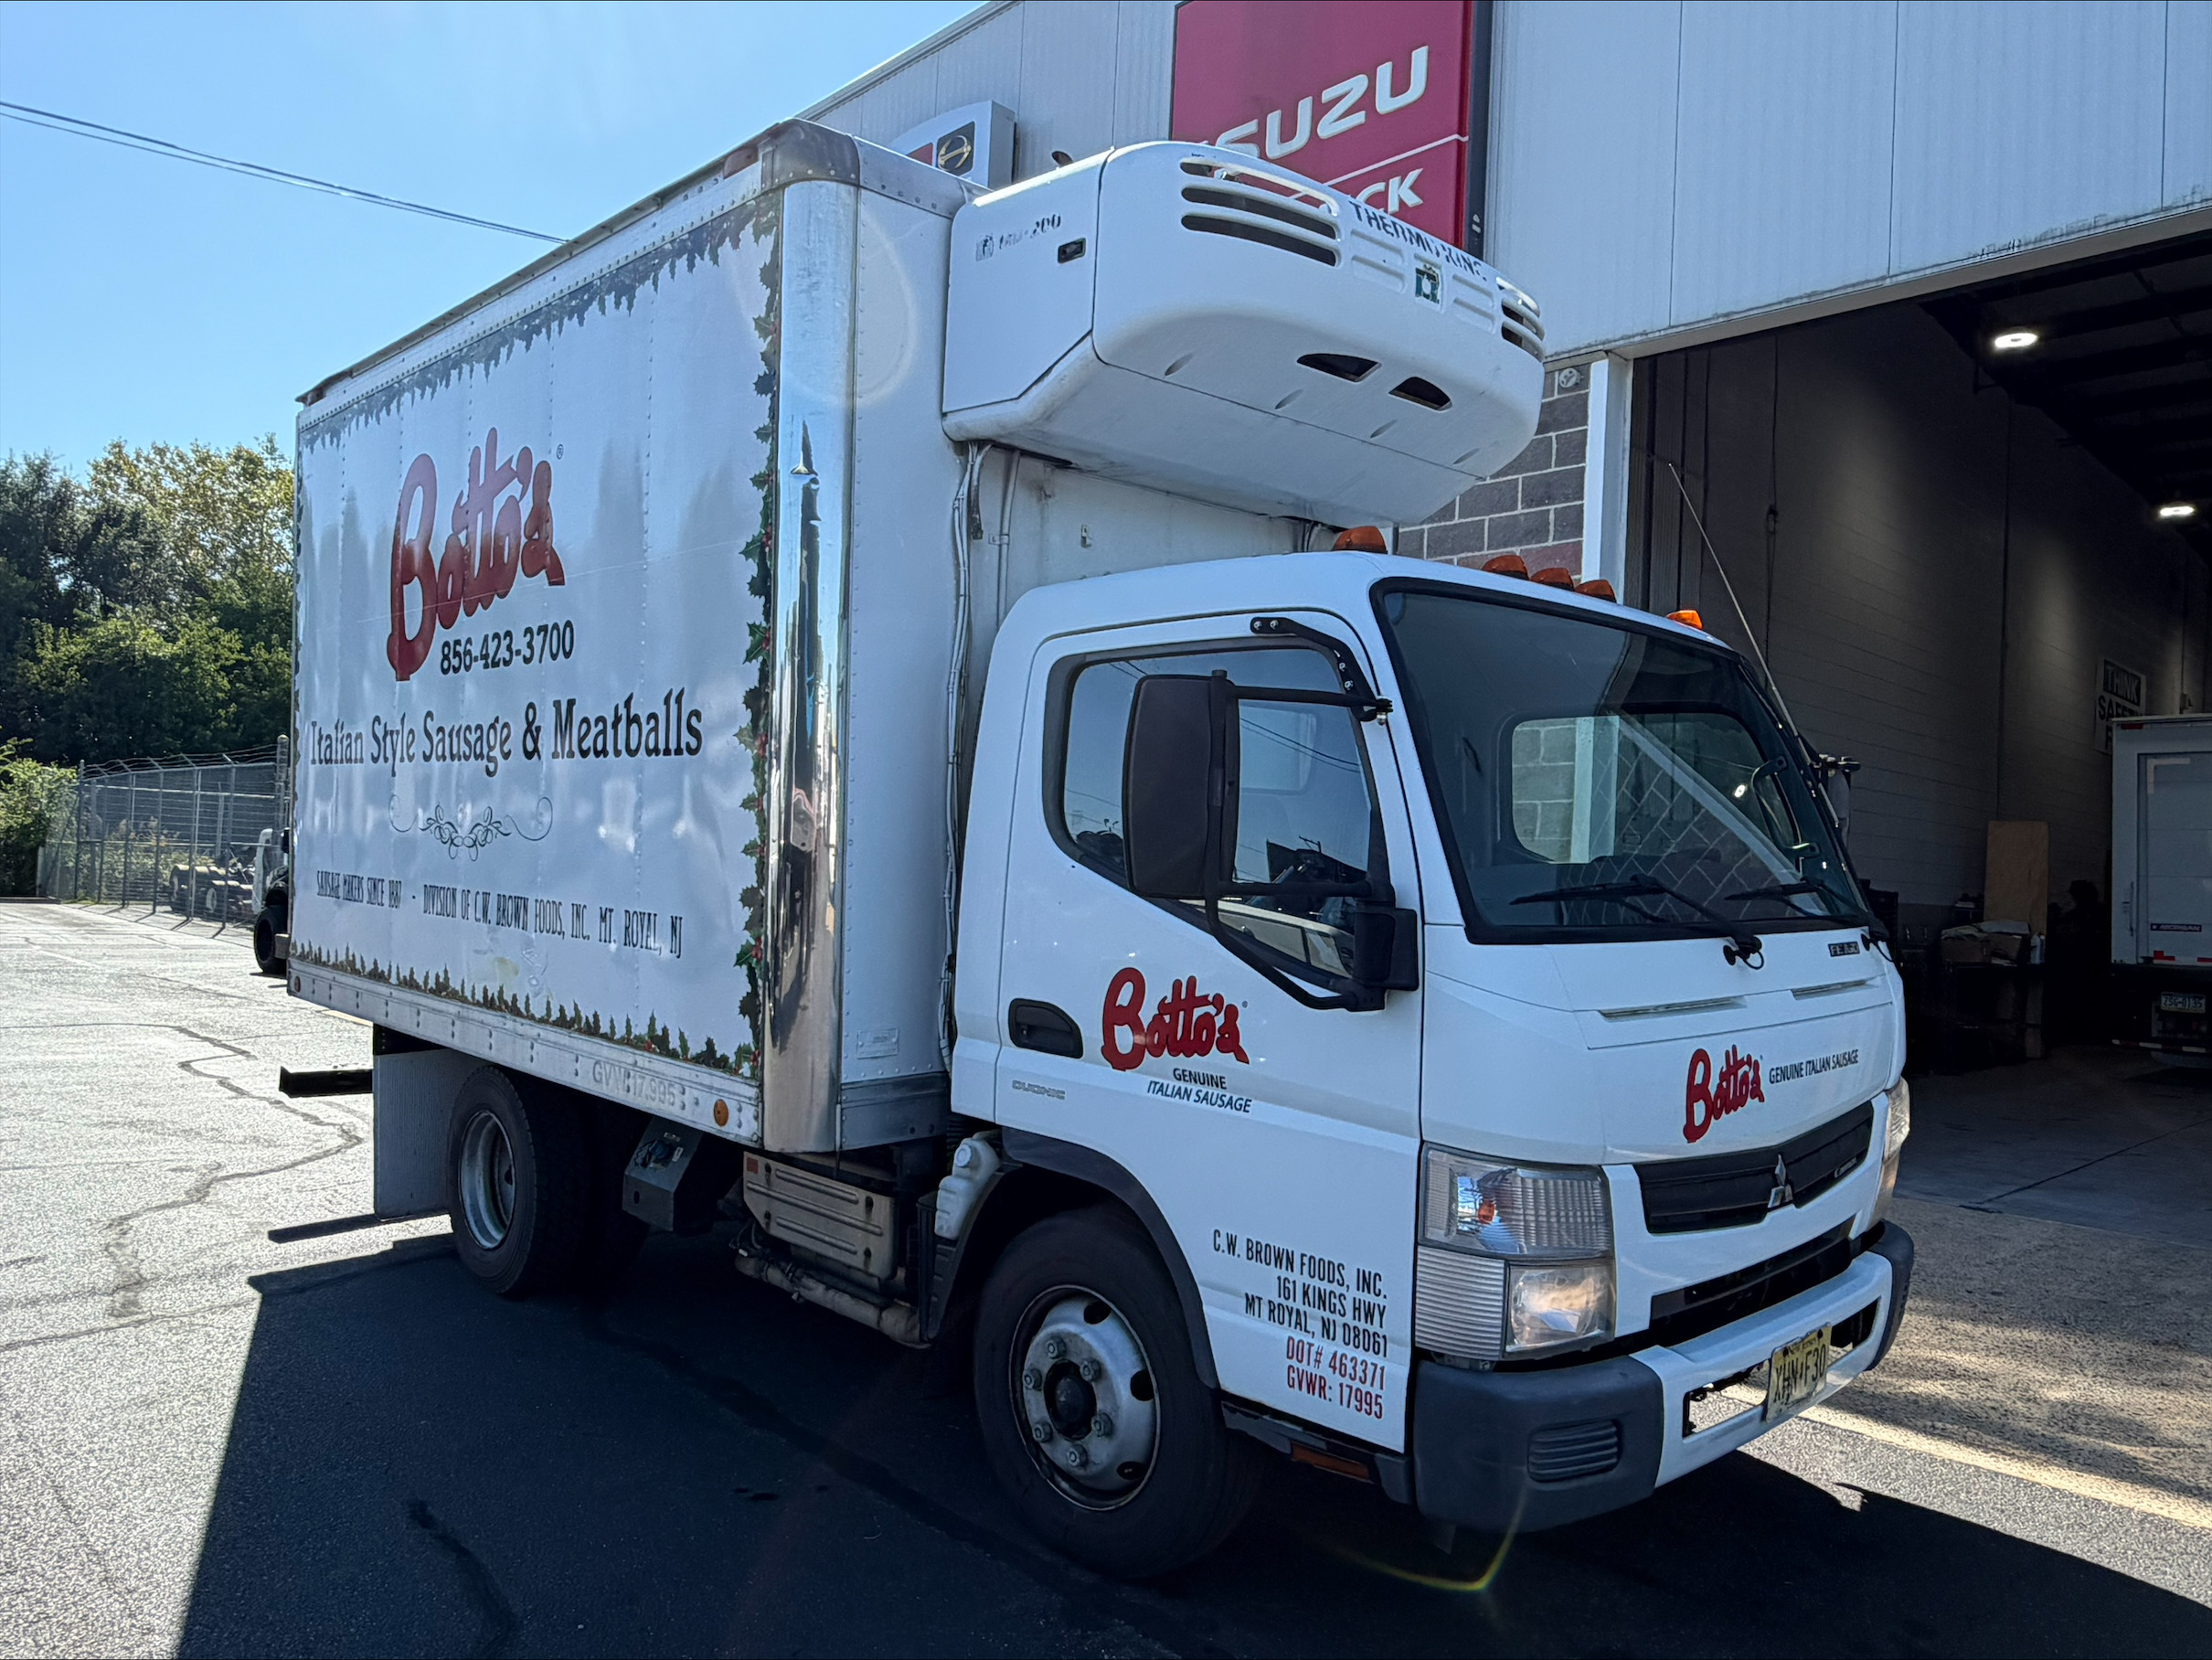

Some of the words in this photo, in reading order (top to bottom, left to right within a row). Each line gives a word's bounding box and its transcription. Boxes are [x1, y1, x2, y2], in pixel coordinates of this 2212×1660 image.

[1200, 46, 1430, 161] SUZU
[387, 426, 565, 681] Botto's
[440, 620, 575, 676] 856-423-3700
[2105, 665, 2139, 703] THINK
[311, 718, 365, 765] Italian
[370, 711, 416, 778] Style
[422, 709, 512, 778] Sausage
[522, 701, 542, 761] &
[551, 686, 703, 760] Meatballs
[423, 884, 458, 919] DIVISION
[461, 889, 471, 920] OF
[473, 890, 492, 925] C.W.
[495, 893, 529, 932] BROWN
[534, 899, 566, 940] FOODS,
[571, 902, 590, 941] INC.
[623, 910, 663, 955] ROYAL,
[670, 915, 684, 959] NJ
[1101, 966, 1250, 1072] Botto's
[1147, 1080, 1193, 1101] ITALIAN
[1194, 1089, 1252, 1113] SAUSAGE
[1173, 1068, 1228, 1090] GENUINE
[1683, 1044, 1765, 1144] Botto's
[1769, 1061, 1804, 1085] GENUINE
[1804, 1057, 1832, 1077] ITALIAN
[1831, 1048, 1859, 1069] SAUSAGE
[1213, 1229, 1241, 1259] C.W.
[1246, 1238, 1294, 1273] BROWN
[1300, 1252, 1351, 1293] FOODS,
[1356, 1268, 1388, 1300] INC.
[1245, 1293, 1263, 1319] MT
[1268, 1299, 1316, 1339] ROYAL,
[1321, 1315, 1337, 1342] NJ
[1343, 1322, 1388, 1358] 08061
[1277, 1275, 1297, 1304] 161
[1303, 1282, 1346, 1318] KINGS
[1353, 1296, 1387, 1329] HWY
[1286, 1335, 1324, 1370] DOT#
[1328, 1350, 1386, 1391] 463371
[1287, 1364, 1333, 1402] GVWR:
[1338, 1382, 1383, 1420] 17995
